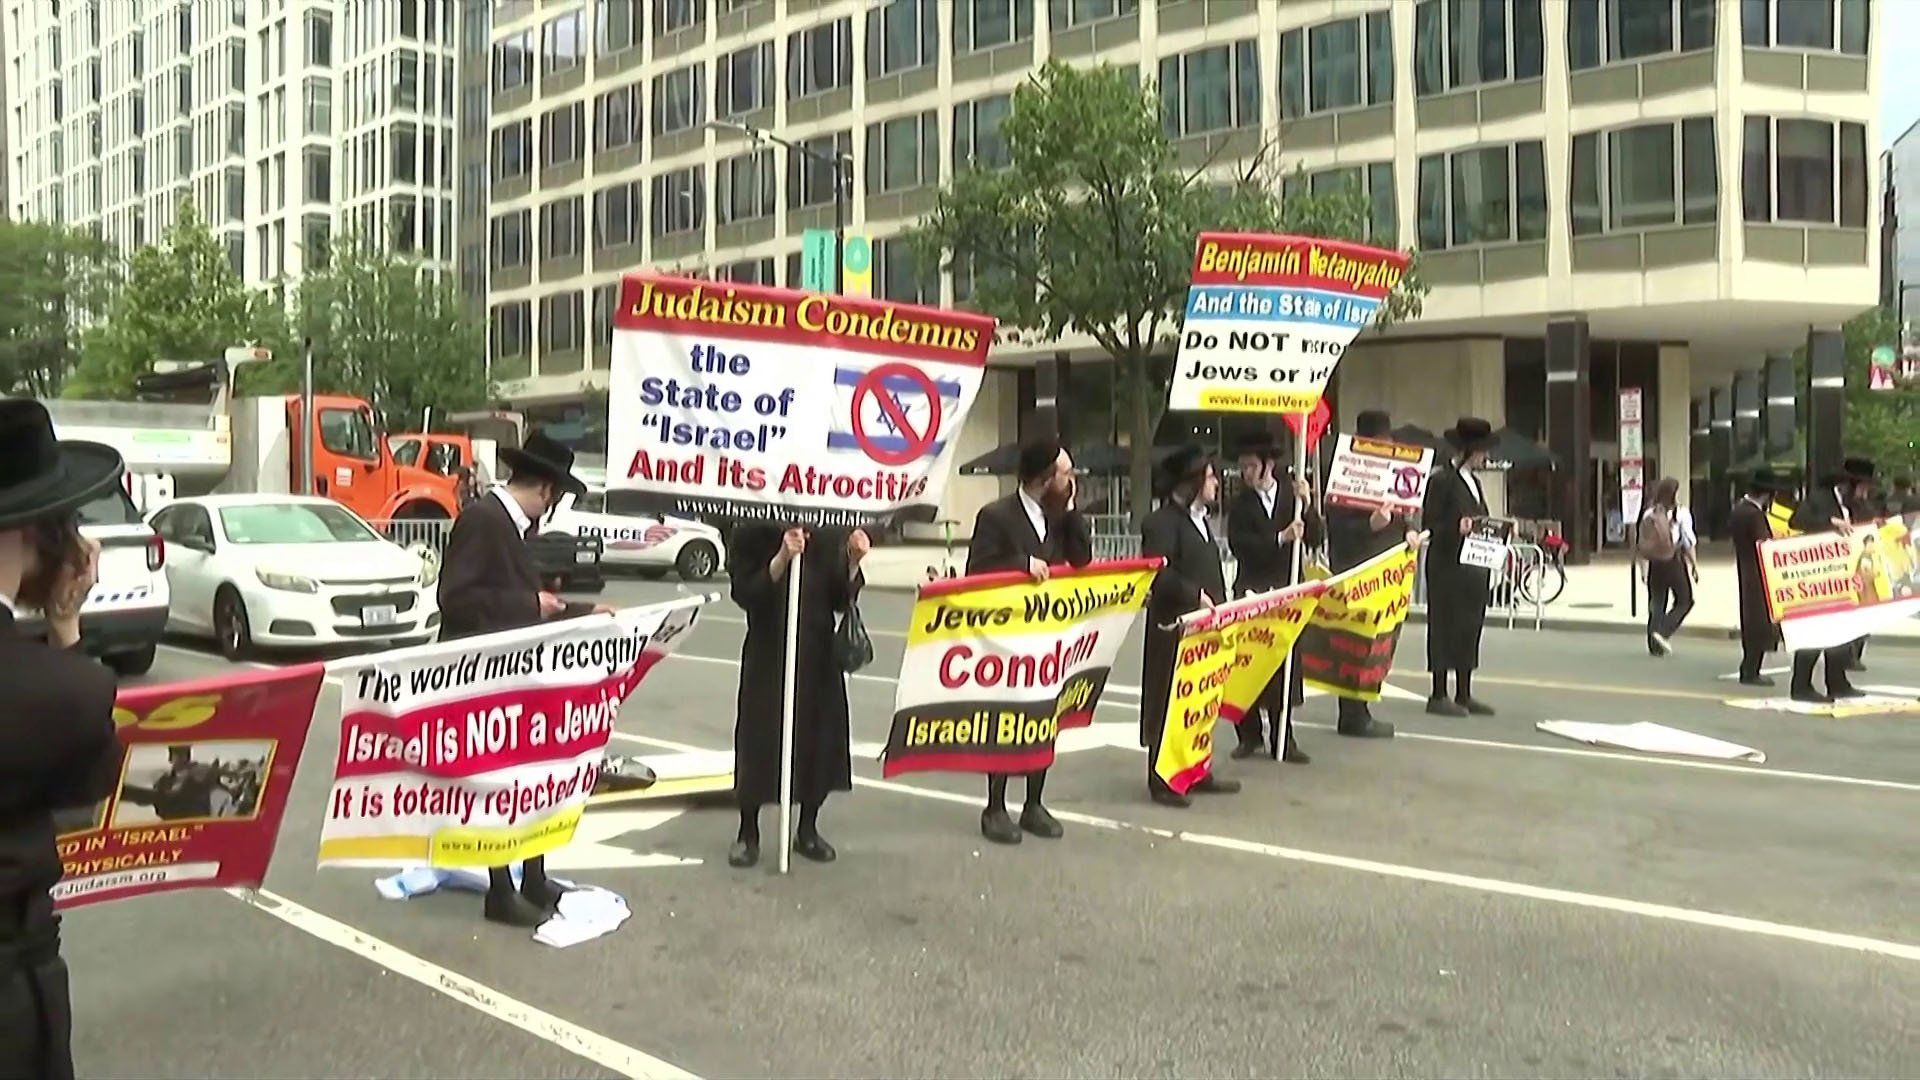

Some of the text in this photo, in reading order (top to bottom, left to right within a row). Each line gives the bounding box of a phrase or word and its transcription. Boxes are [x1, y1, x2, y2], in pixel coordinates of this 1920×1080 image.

[1200, 241, 1401, 291] Benjamin Netanyahu
[632, 281, 980, 352] Judaism Condemns
[1192, 291, 1233, 314] And
[1239, 291, 1273, 314] the
[1324, 299, 1341, 320] of
[1185, 331, 1218, 350] Do
[1229, 332, 1290, 352] NOT
[690, 343, 751, 376] the
[1185, 360, 1259, 382] Jews
[1269, 366, 1300, 383] or
[640, 376, 795, 417] State of
[627, 448, 704, 486] And
[716, 456, 767, 491] its
[578, 525, 642, 542] POLICE
[1772, 541, 1851, 569] Arsonists
[1775, 574, 1864, 603] as Saviors
[926, 605, 1013, 634] Jews
[358, 668, 400, 703] The
[411, 652, 482, 696] world
[484, 642, 544, 682] must
[346, 721, 428, 766] Israel
[435, 722, 458, 765] is
[466, 703, 524, 758] NOT
[530, 711, 547, 746] a
[906, 711, 989, 746] Israeli
[332, 785, 354, 820] It
[361, 783, 384, 819] is
[393, 779, 478, 825] totally
[484, 766, 579, 826] rejected
[85, 836, 107, 851] IN
[63, 850, 183, 876] PHYSICALLY
